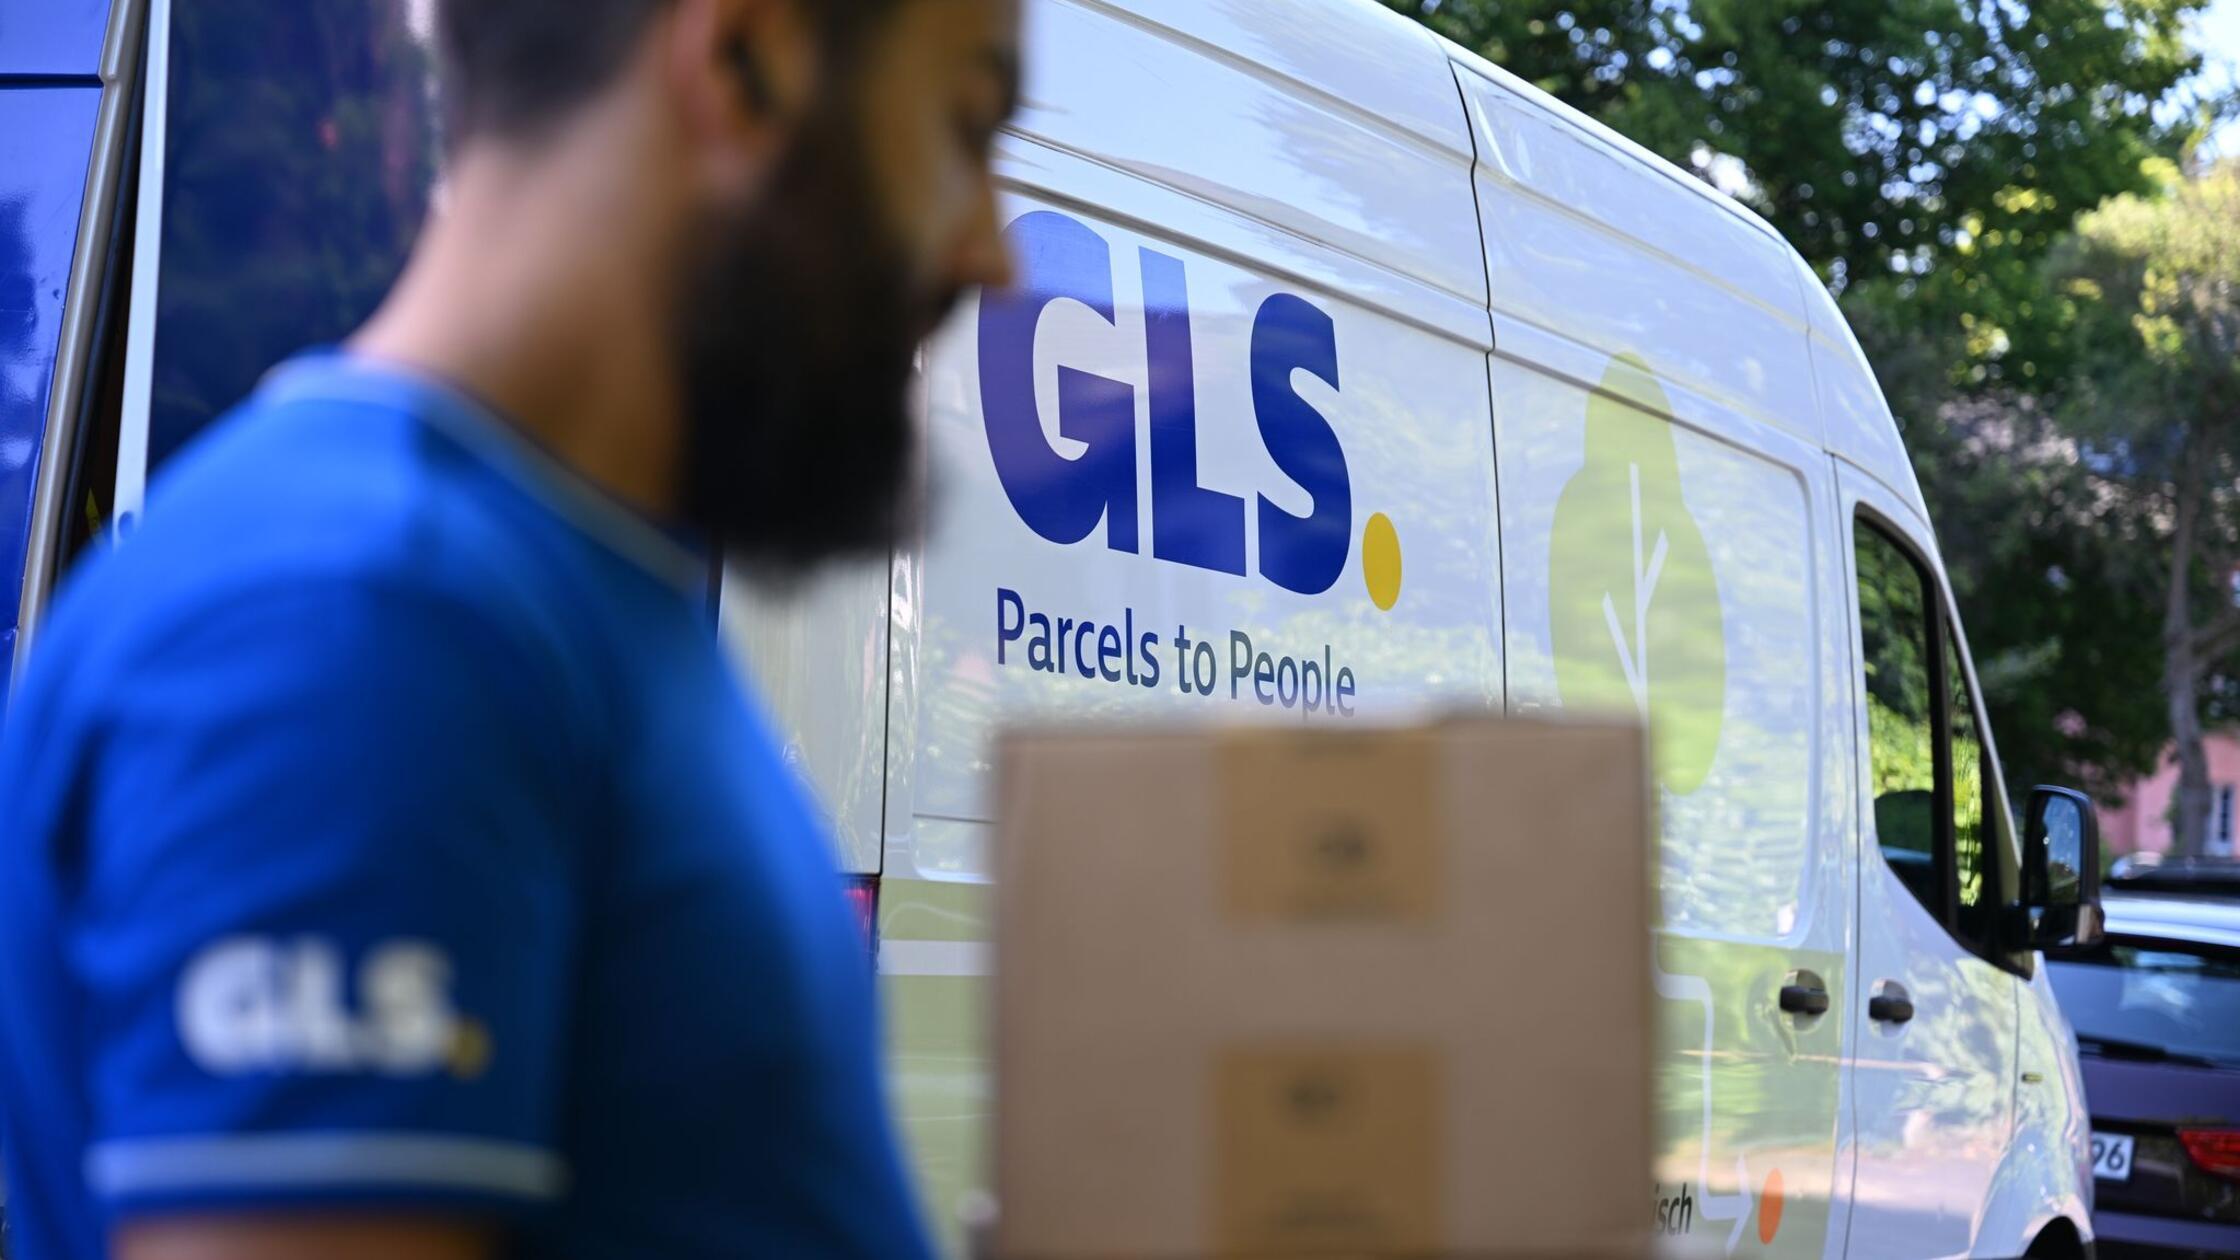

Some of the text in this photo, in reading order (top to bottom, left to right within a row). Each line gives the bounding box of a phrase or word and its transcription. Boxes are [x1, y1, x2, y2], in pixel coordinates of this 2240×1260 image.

[996, 587, 1356, 724] Parcels to People
